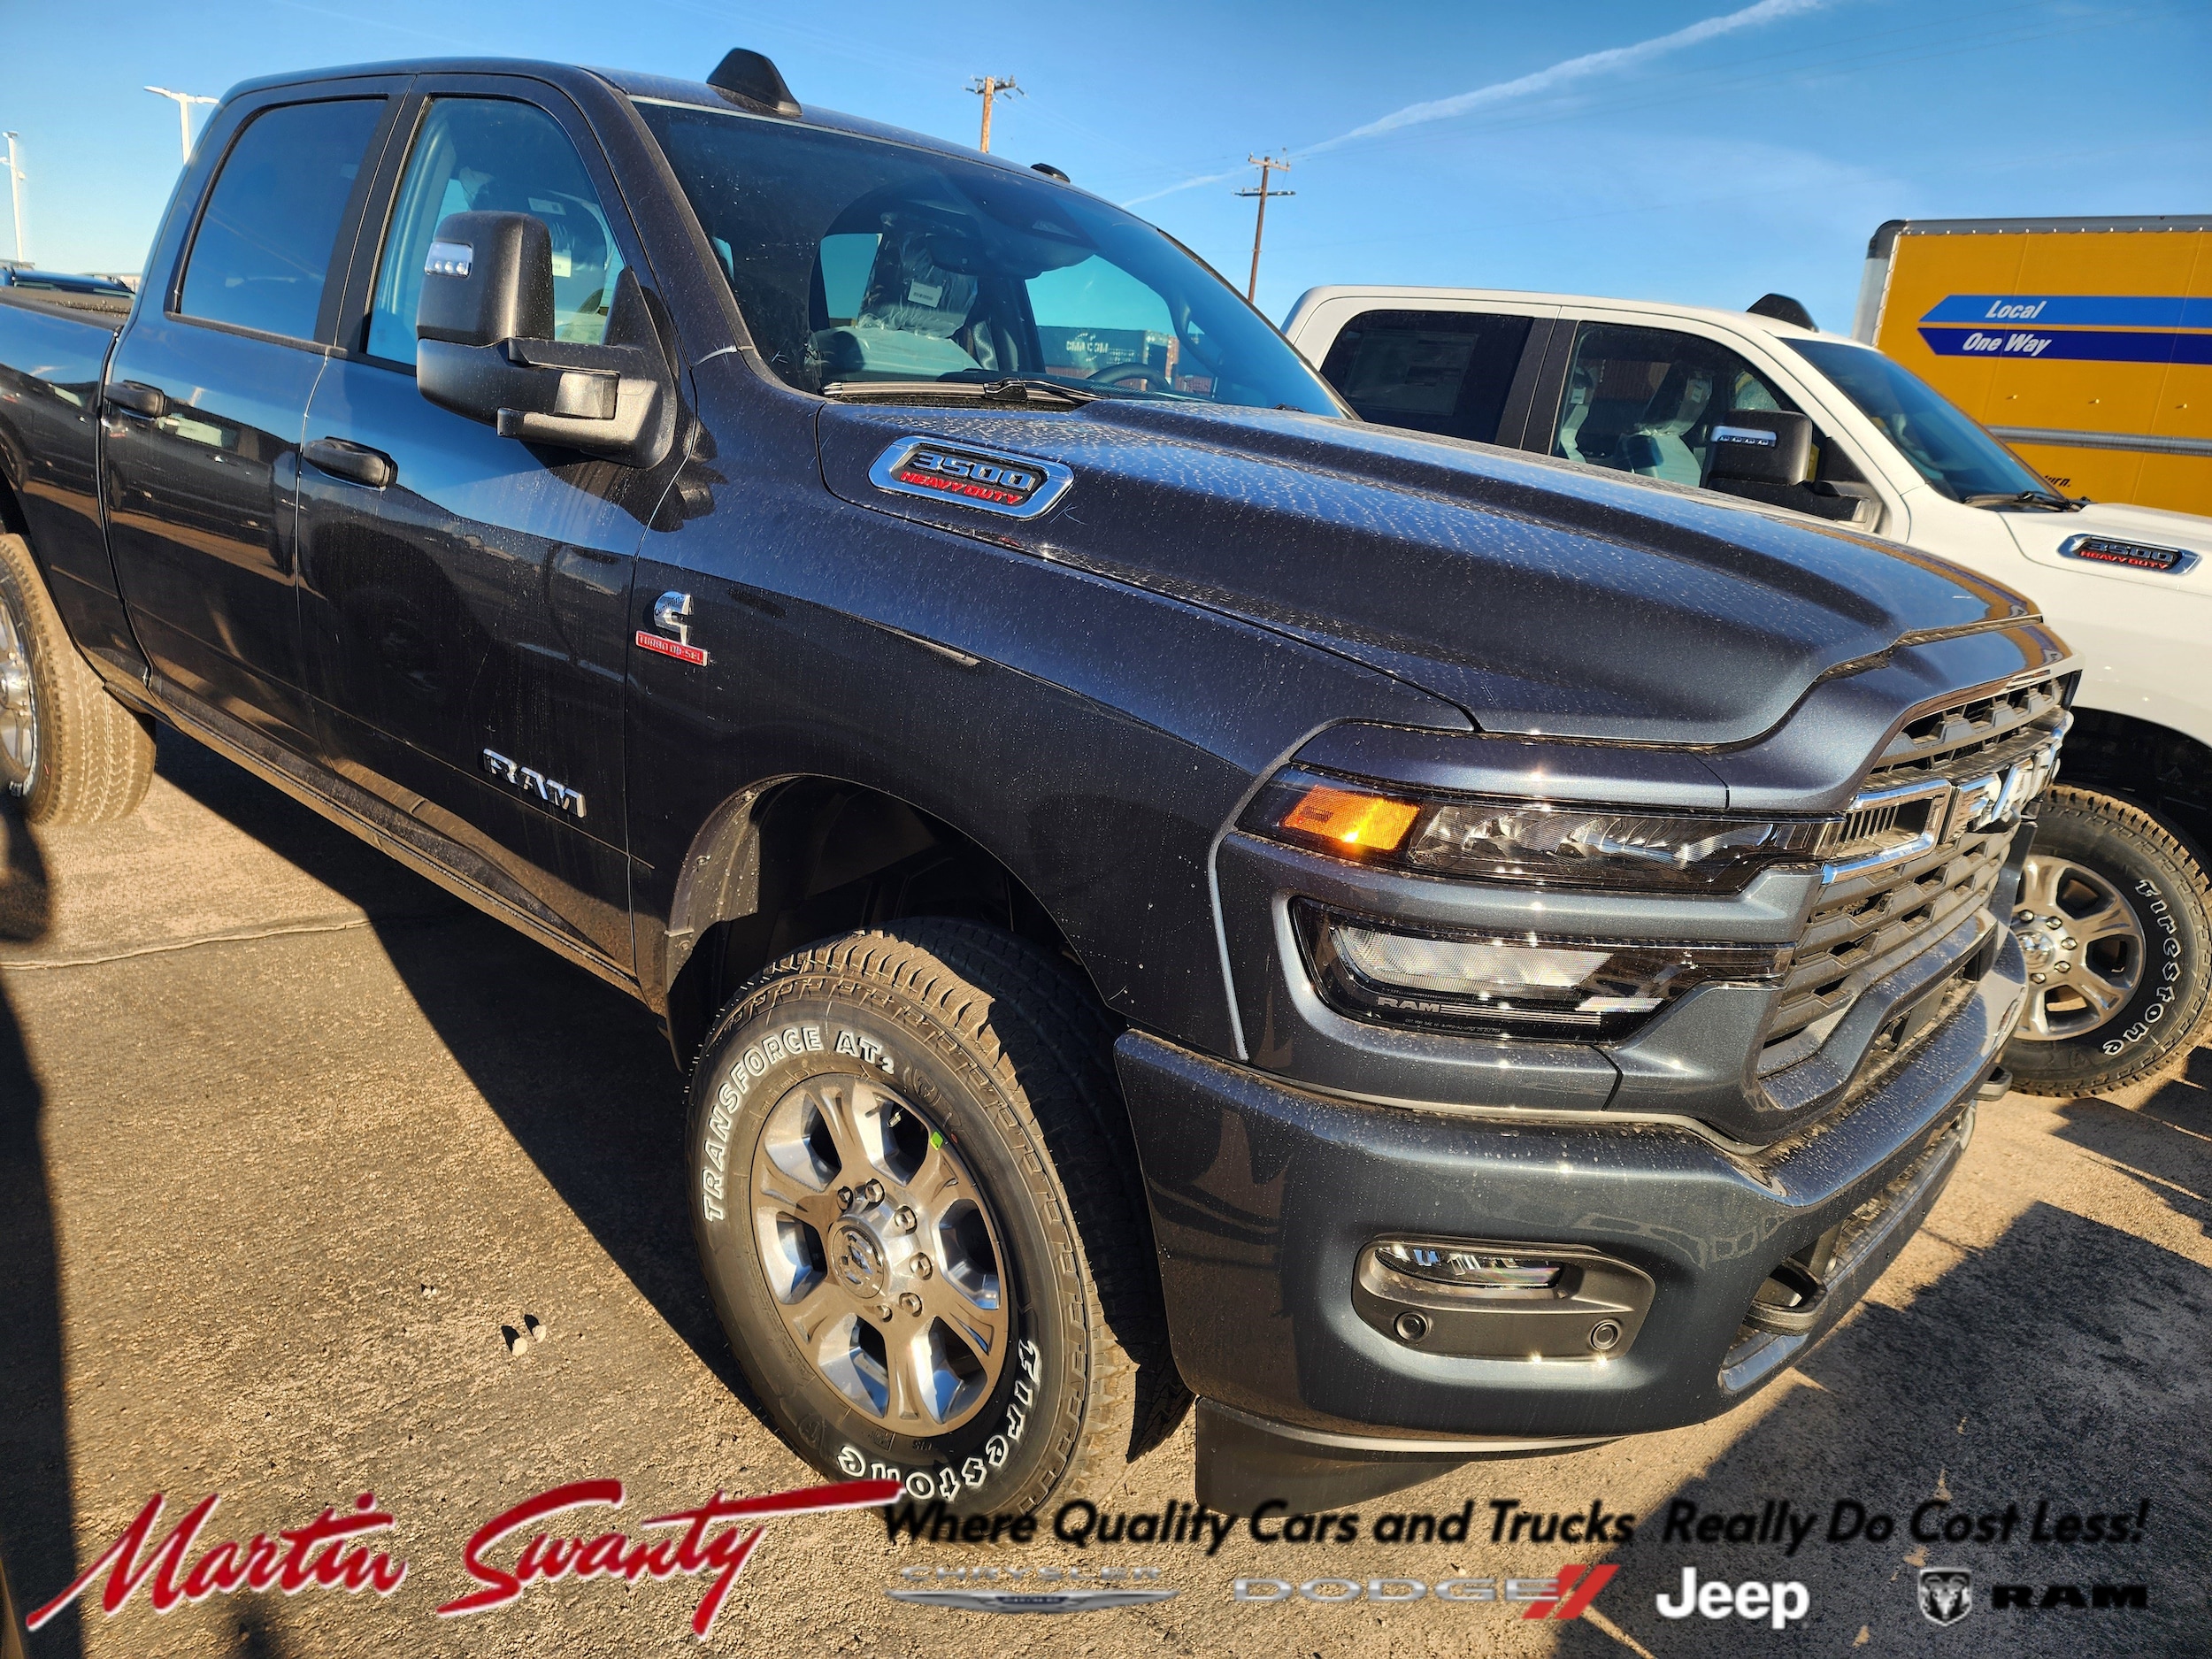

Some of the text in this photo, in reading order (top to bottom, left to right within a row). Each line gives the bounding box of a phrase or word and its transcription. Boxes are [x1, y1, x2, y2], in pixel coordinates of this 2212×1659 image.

[1985, 300, 2047, 319] Local
[1962, 332, 2052, 357] One Way
[911, 450, 1035, 491] 3500
[2086, 542, 2175, 564] 3500
[483, 748, 587, 818] RAM
[2102, 879, 2181, 1056] Firestone
[1377, 996, 1440, 1013] RAM
[702, 1025, 826, 1222] TRANSFORCE
